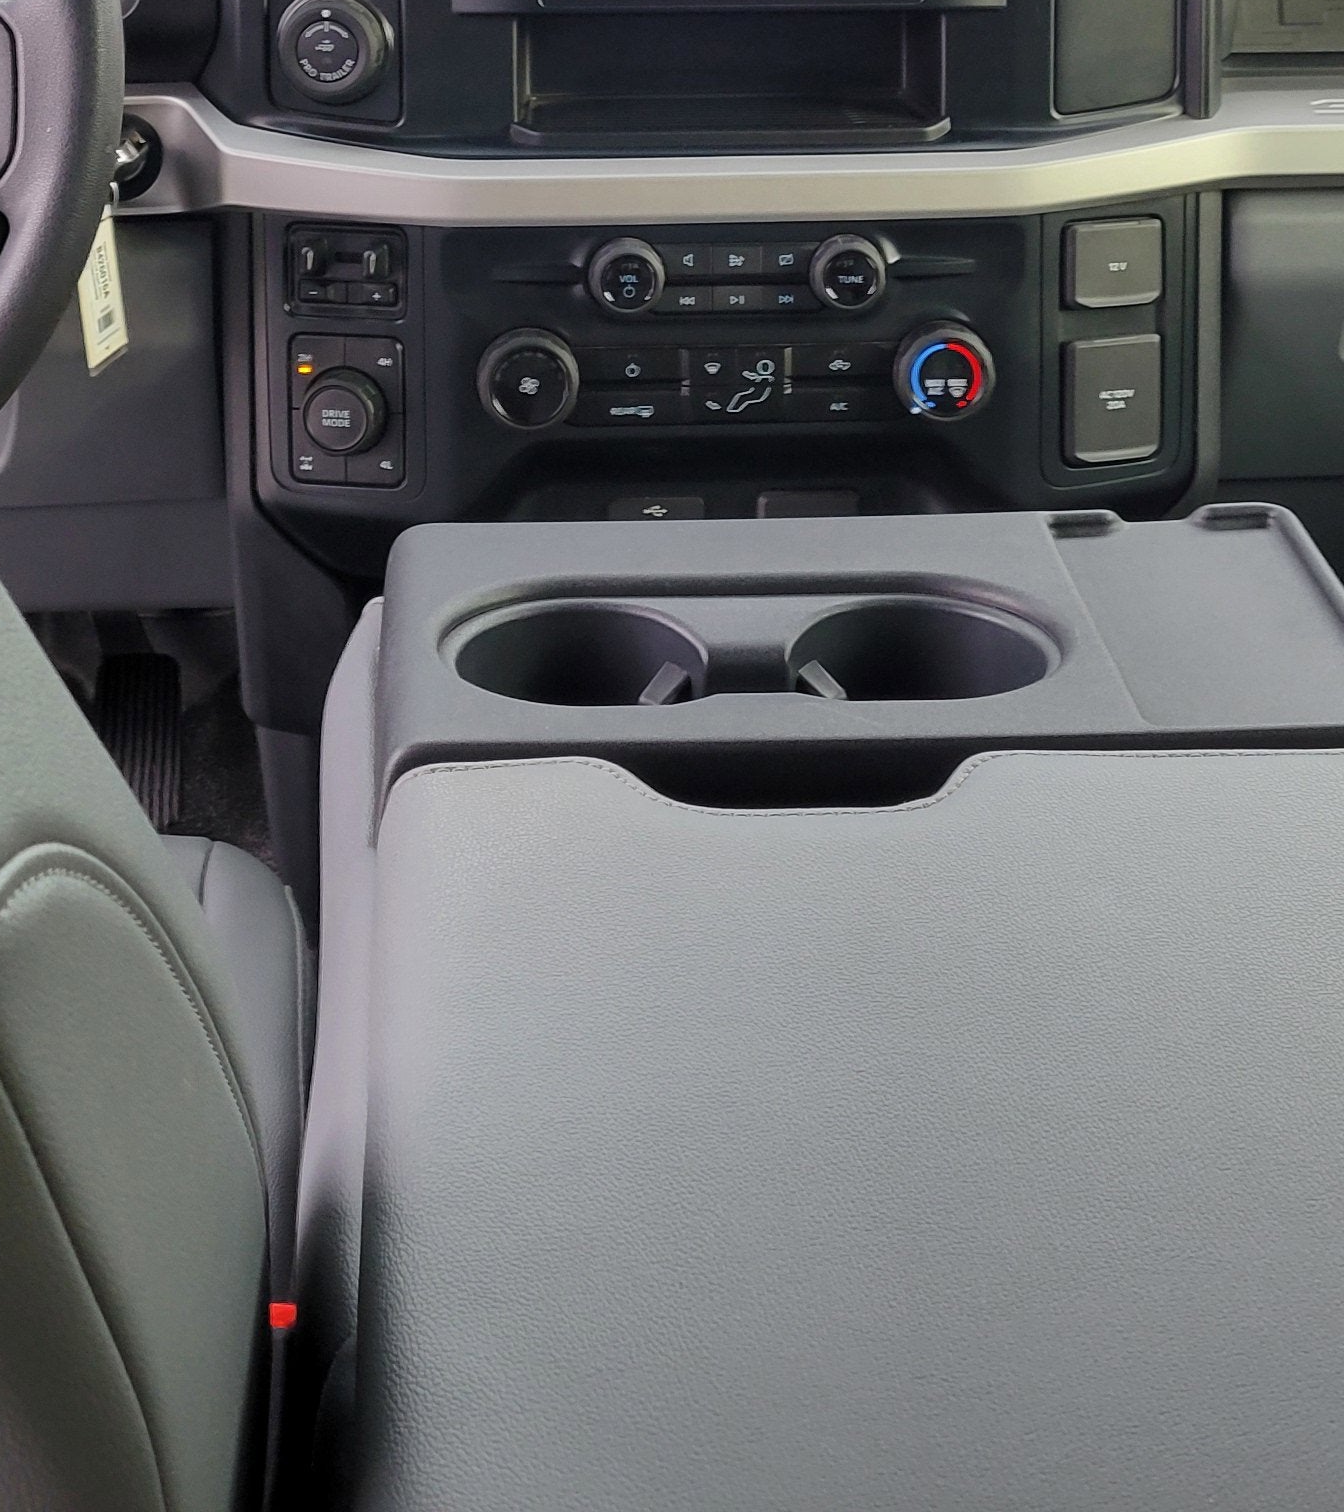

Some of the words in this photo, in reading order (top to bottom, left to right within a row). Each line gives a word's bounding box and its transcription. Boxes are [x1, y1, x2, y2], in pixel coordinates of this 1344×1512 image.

[299, 58, 318, 77] PRO
[319, 58, 356, 82] TRAILER
[619, 274, 639, 283] VOL
[837, 275, 864, 285] TUNE
[321, 409, 351, 419] DRIVE
[321, 418, 351, 428] MODE
